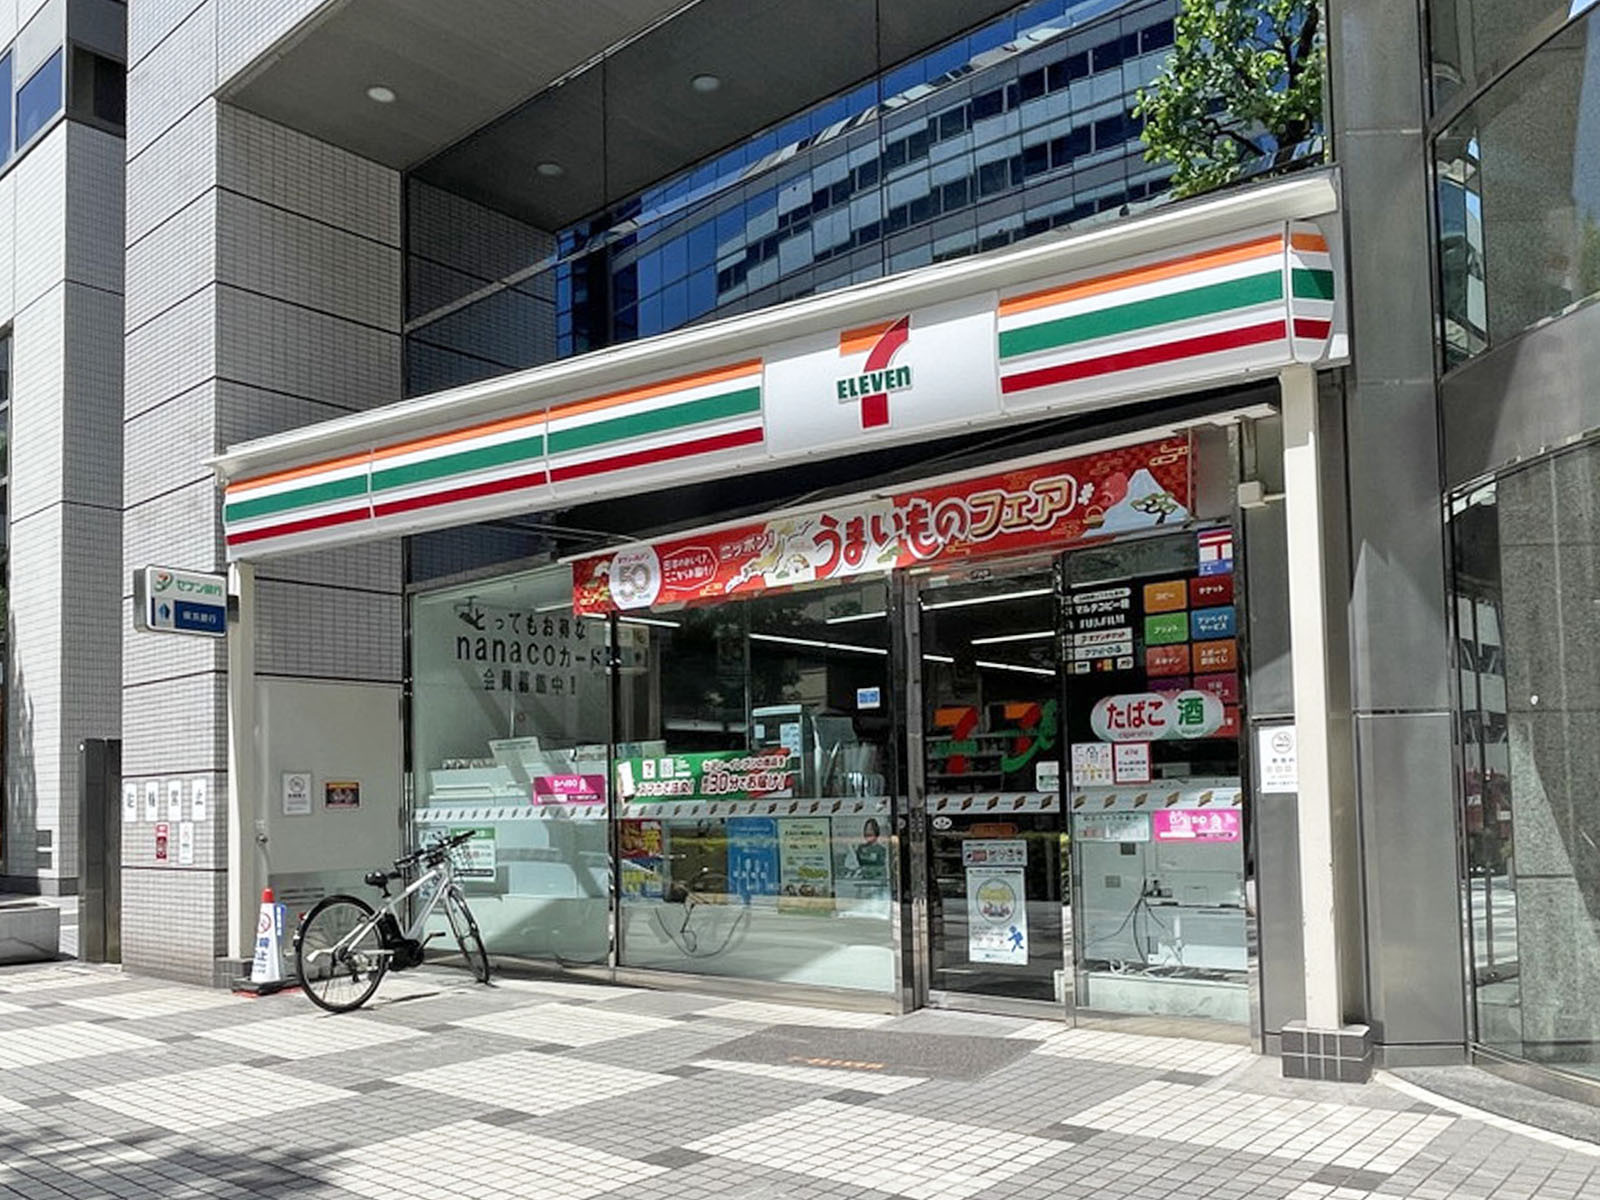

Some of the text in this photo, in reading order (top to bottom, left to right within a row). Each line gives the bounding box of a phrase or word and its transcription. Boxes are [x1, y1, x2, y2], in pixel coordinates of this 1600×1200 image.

[840, 315, 909, 428] 7
[812, 477, 1076, 580] うまいものフェア
[473, 606, 587, 639] とってもお得な
[1106, 697, 1205, 729] たばこ 酒
